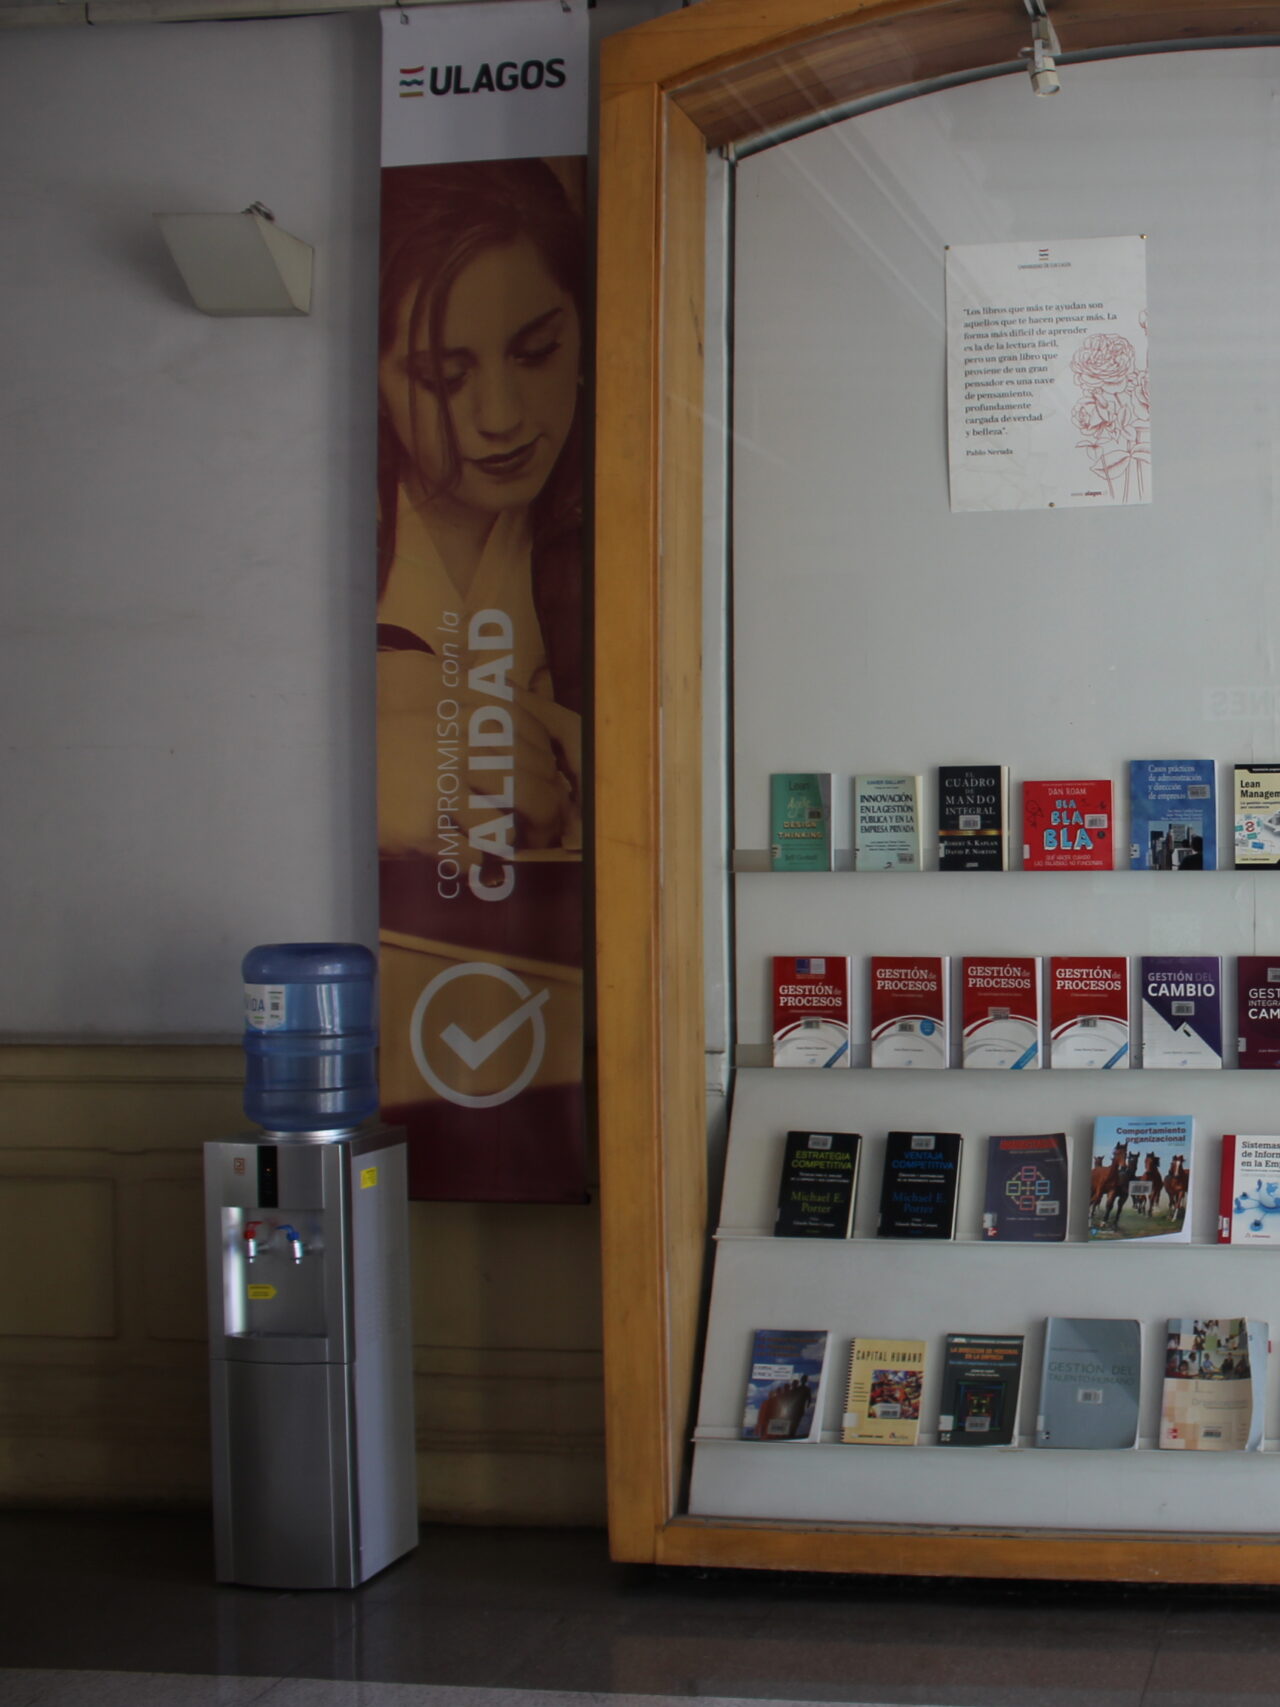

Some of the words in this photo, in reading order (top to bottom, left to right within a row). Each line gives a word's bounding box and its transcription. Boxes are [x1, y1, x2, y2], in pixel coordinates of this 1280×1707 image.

[430, 58, 566, 95] ULAGOS
[982, 306, 1007, 314] libros
[1026, 304, 1043, 312] más
[1055, 302, 1086, 311] ayudan
[437, 610, 459, 633] la
[443, 642, 459, 687] con
[468, 609, 515, 901] CALIDAD
[945, 778, 995, 787] CUADRO
[1240, 780, 1260, 788] Lean
[1048, 788, 1063, 796] DAN
[437, 699, 459, 899] COMPROMISO
[860, 793, 913, 803] INNOVACIÓN
[946, 795, 995, 805] MANDO
[860, 805, 869, 813] EN
[870, 805, 879, 813] LA
[879, 804, 914, 813] GESTIÓN
[1056, 800, 1077, 809] BLA
[945, 807, 996, 815] INTEGRAL
[860, 814, 887, 824] PÚBLICA
[1051, 810, 1084, 825] BLA
[861, 825, 888, 834] EMPRESA
[889, 824, 914, 833] PRIVADA
[1044, 828, 1093, 850] BLA
[877, 967, 928, 979] GESTIÓN
[968, 964, 1021, 977] GESTIÓN
[1056, 965, 1112, 979] GESTIÓN
[1148, 970, 1193, 982] GESTIÓN
[877, 981, 937, 991] PROCESOS
[968, 978, 1031, 988] PROCESOS
[1056, 980, 1121, 990] PROCESOS
[779, 982, 833, 995] GESTIÓN
[1148, 983, 1215, 997] CAMBIO
[779, 996, 842, 1006] PROCESOS
[1116, 1127, 1186, 1135] Comportamiento
[1125, 1135, 1186, 1144] organizacional
[1241, 1141, 1280, 1150] Sistemas
[796, 1151, 850, 1160] ESTRATEGIA
[904, 1151, 944, 1160] VENTAJA
[1241, 1150, 1253, 1158] de
[791, 1160, 852, 1170] COMPETITIVA
[892, 1160, 954, 1170] COMPETITIVA
[856, 1350, 888, 1362] CAPITAL
